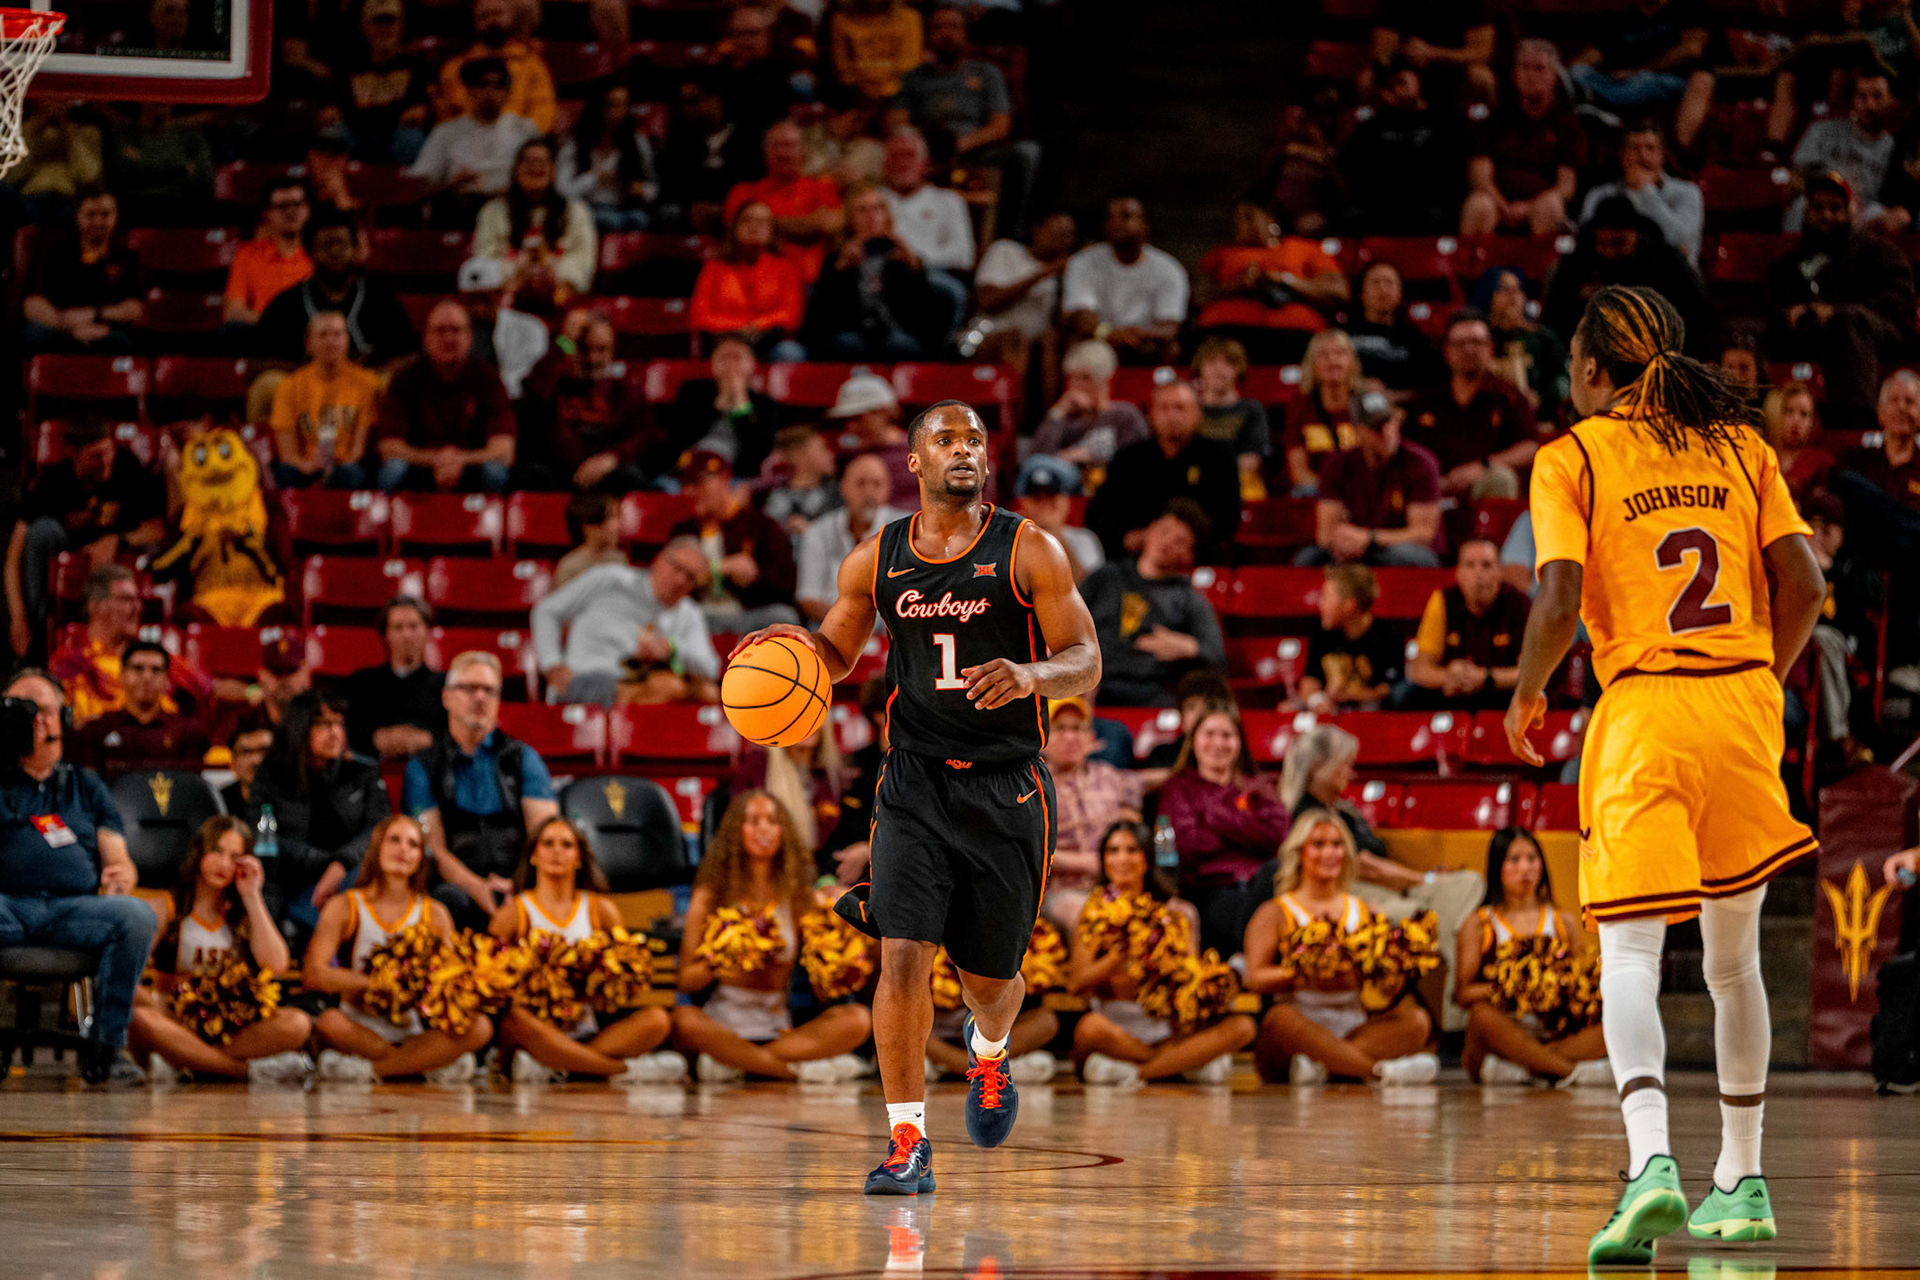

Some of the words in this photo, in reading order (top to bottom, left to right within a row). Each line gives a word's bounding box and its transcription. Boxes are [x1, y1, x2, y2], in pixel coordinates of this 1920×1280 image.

[1622, 484, 1729, 522] JOHNSON
[1654, 526, 1732, 636] 2
[895, 589, 991, 623] Cowboys
[932, 633, 966, 690] 1
